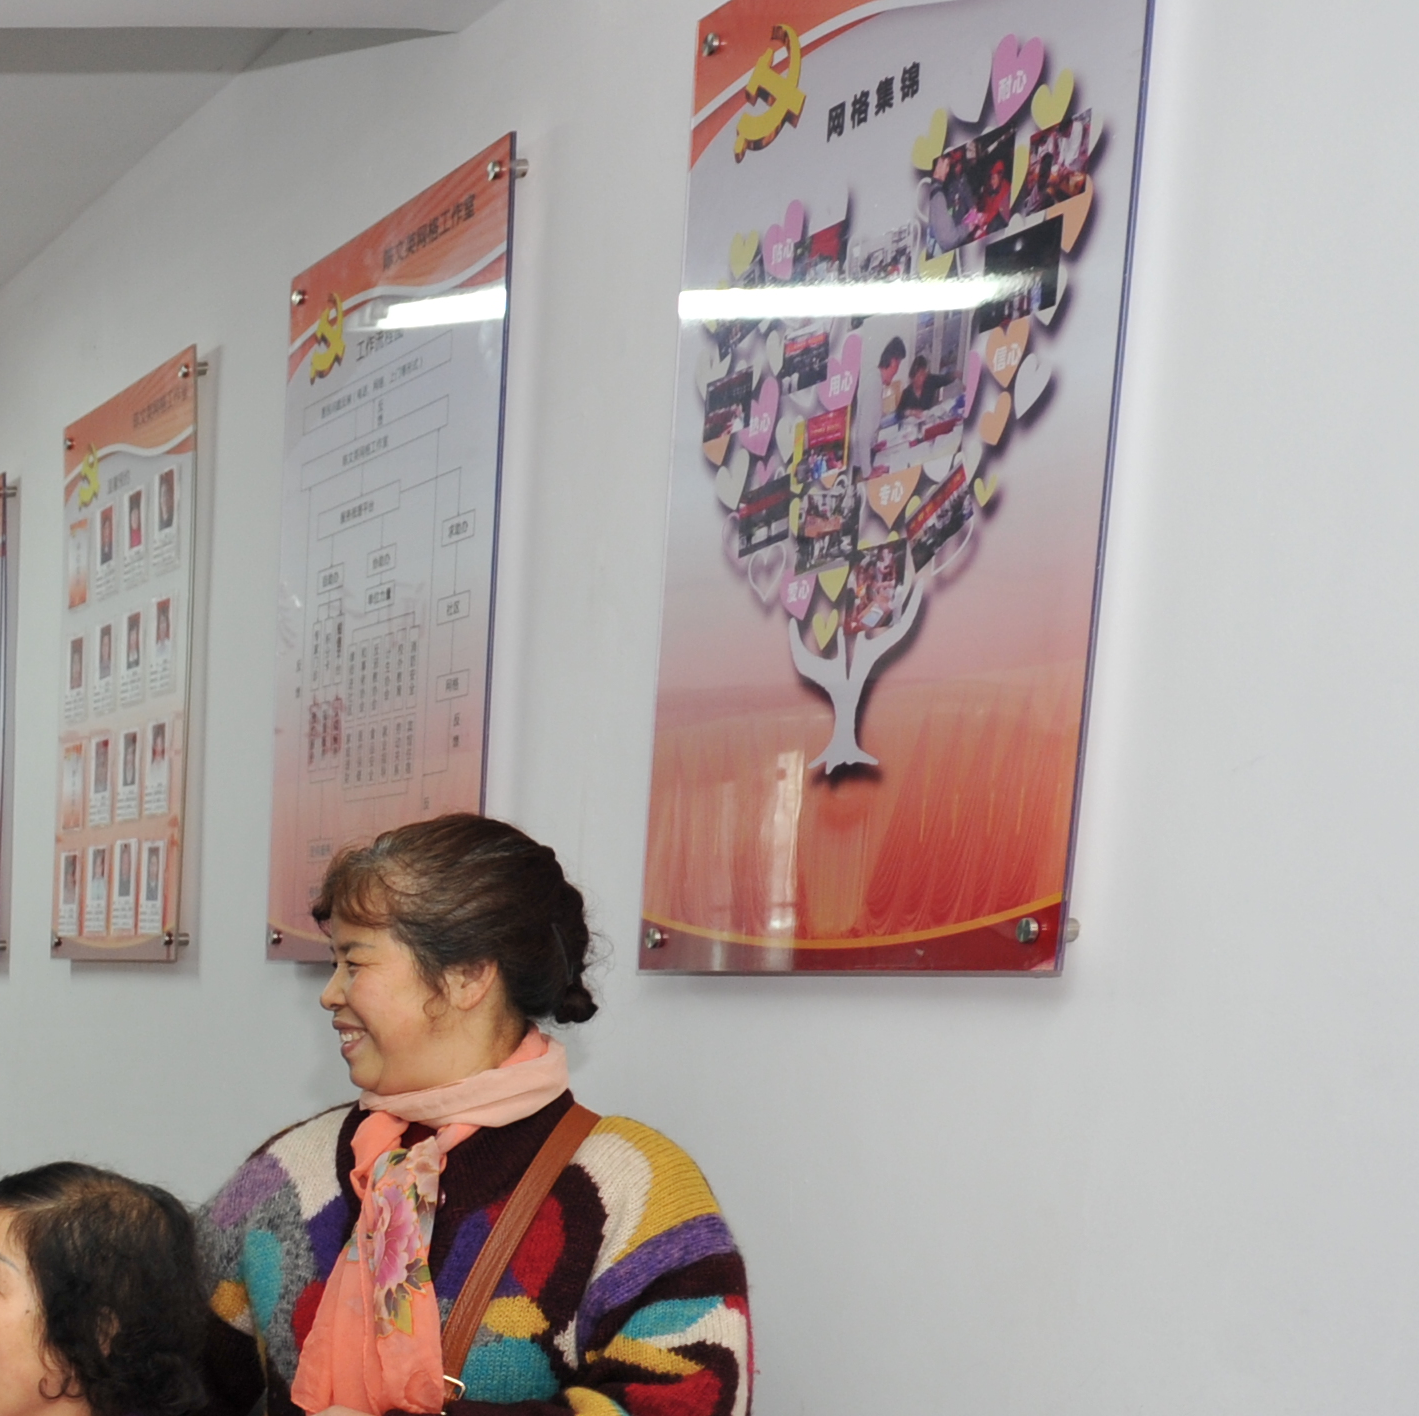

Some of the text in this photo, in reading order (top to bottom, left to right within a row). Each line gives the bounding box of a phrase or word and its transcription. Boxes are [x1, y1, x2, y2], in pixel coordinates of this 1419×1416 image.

[826, 61, 921, 142] 网格集锦
[997, 70, 1027, 103] 耐心
[828, 371, 853, 397] 用心
